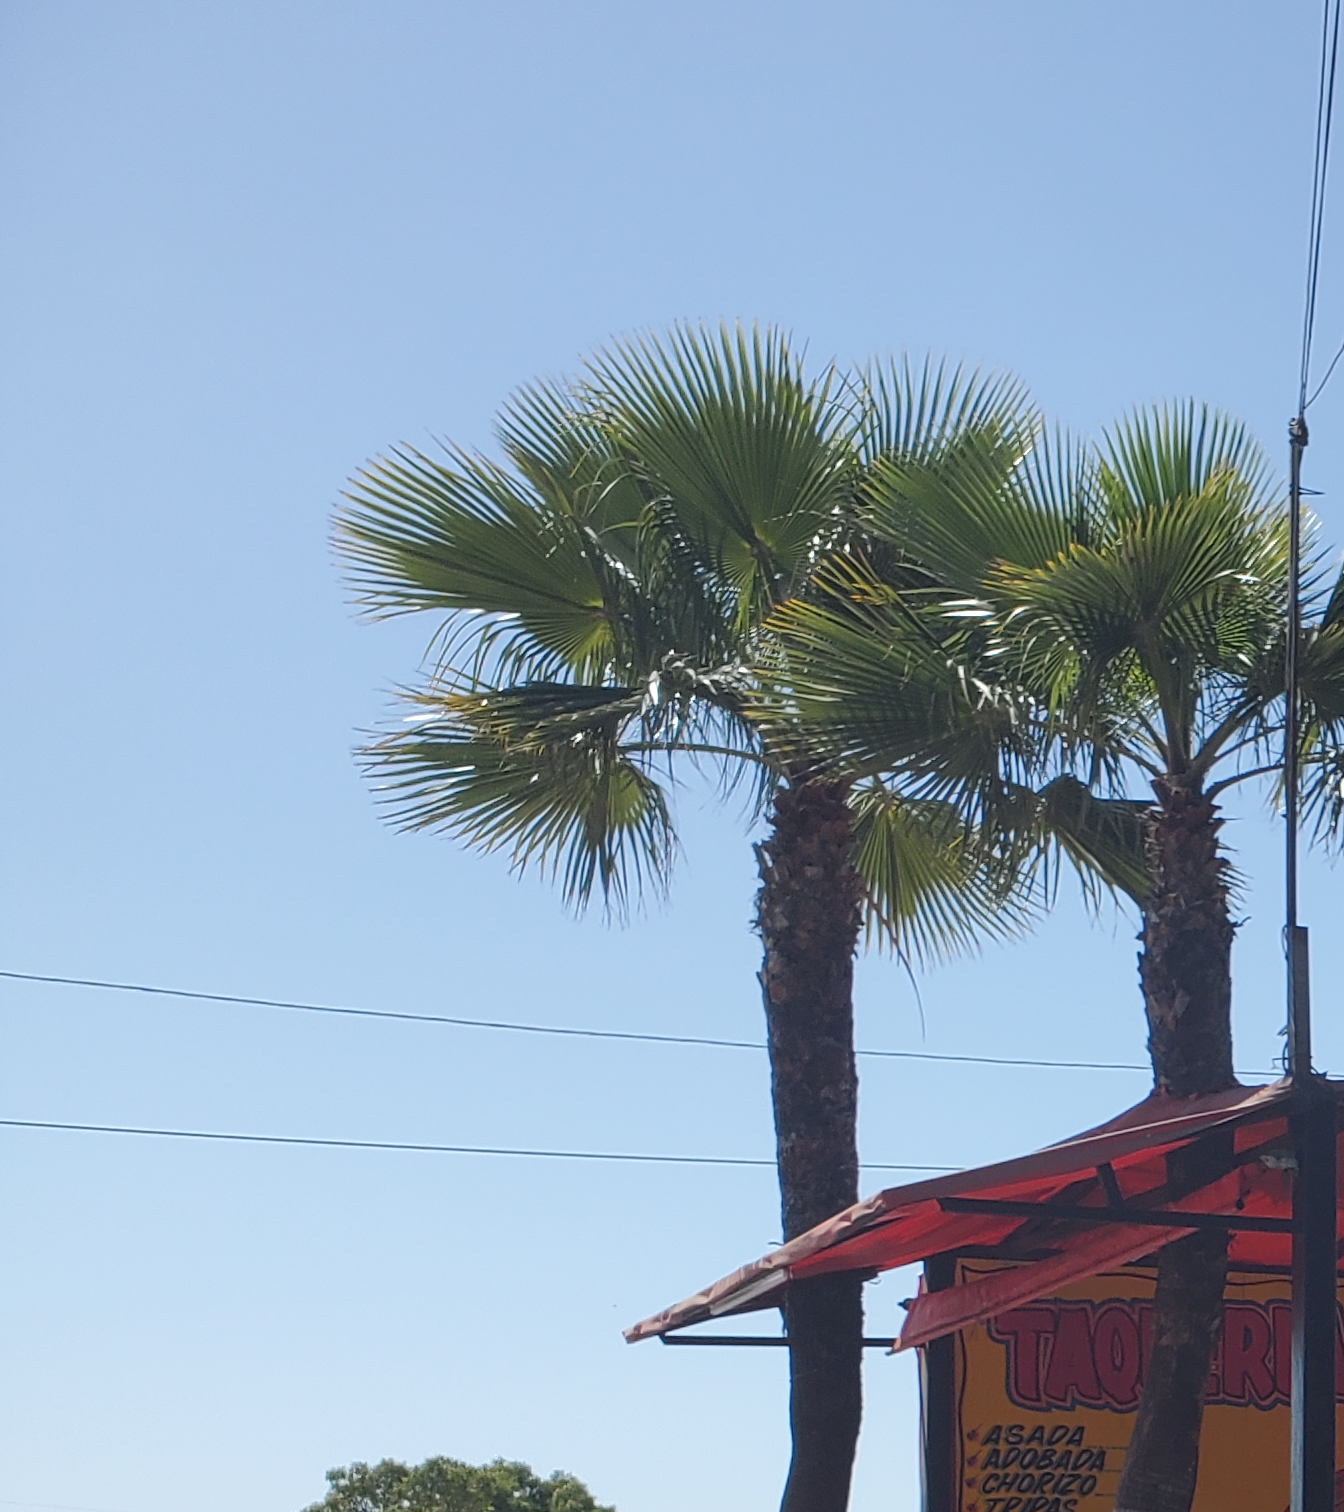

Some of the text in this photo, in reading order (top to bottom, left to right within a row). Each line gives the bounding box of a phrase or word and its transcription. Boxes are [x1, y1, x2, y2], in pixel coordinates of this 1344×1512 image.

[981, 1425, 1086, 1447] ASADA
[980, 1447, 1107, 1472] ADOBADA
[980, 1471, 1098, 1495] CHORIZO
